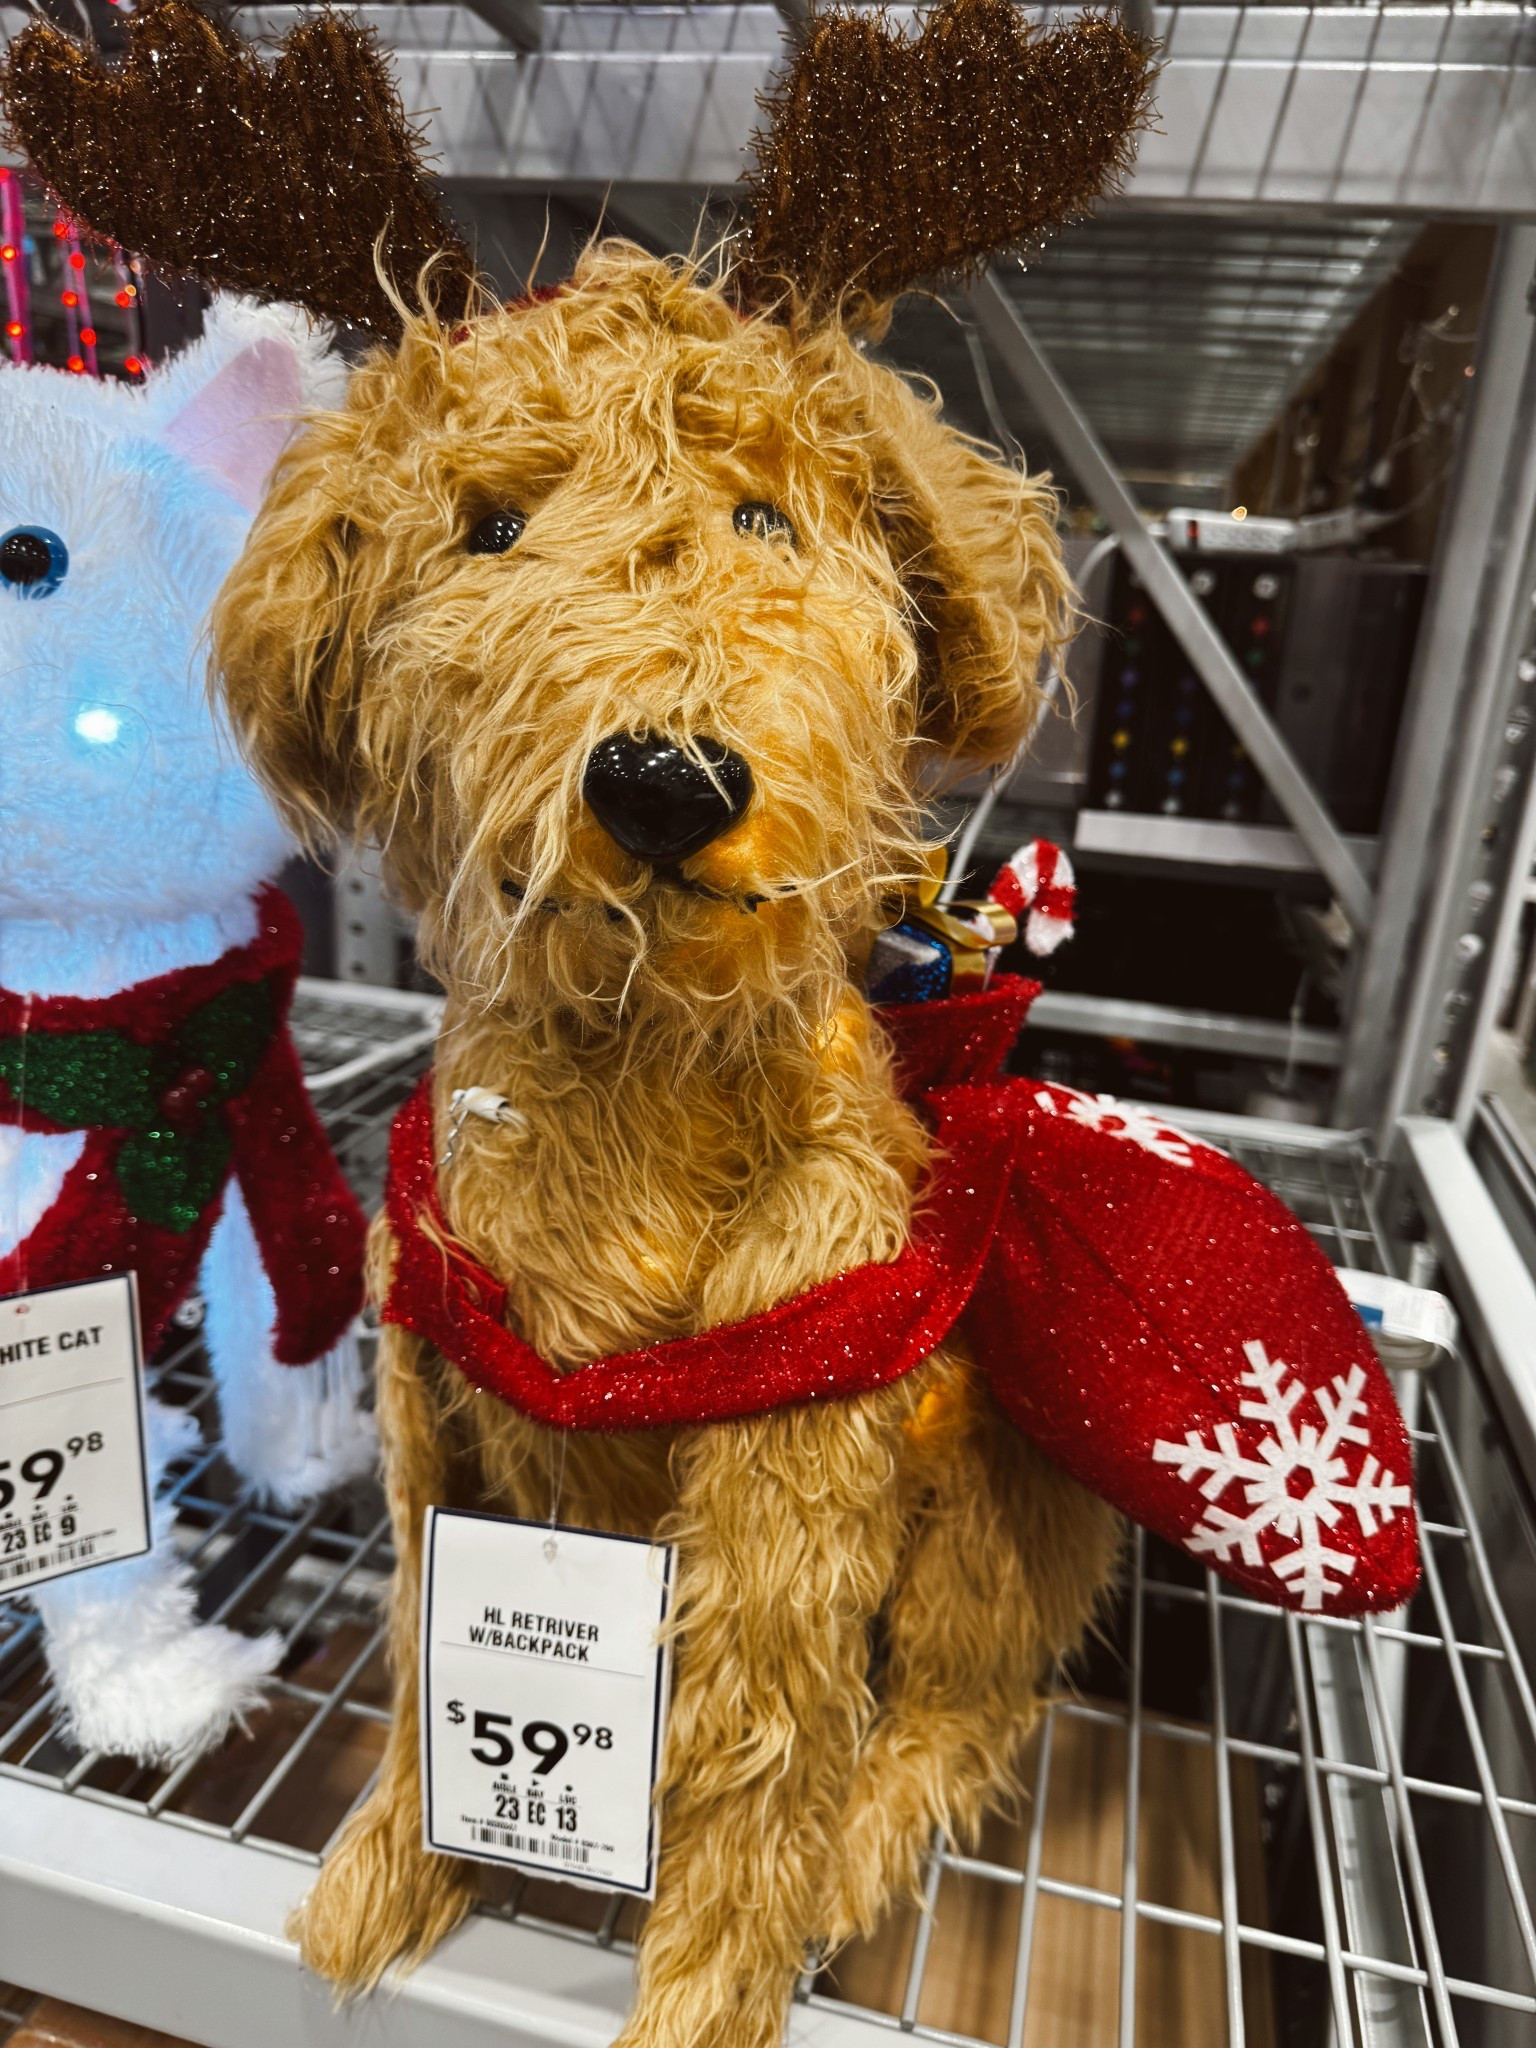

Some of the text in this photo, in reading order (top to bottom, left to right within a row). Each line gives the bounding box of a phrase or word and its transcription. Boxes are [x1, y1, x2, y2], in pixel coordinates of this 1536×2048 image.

[0, 1326, 103, 1366] HITE CAT
[3, 1529, 27, 1553] 23
[34, 1521, 51, 1544] EC
[61, 1514, 76, 1536] 9
[484, 1606, 599, 1642] HL RETRIVER
[469, 1625, 589, 1662] W/BACKPACK
[495, 1794, 519, 1820] 23
[528, 1800, 545, 1826] EC
[556, 1806, 577, 1832] 13
